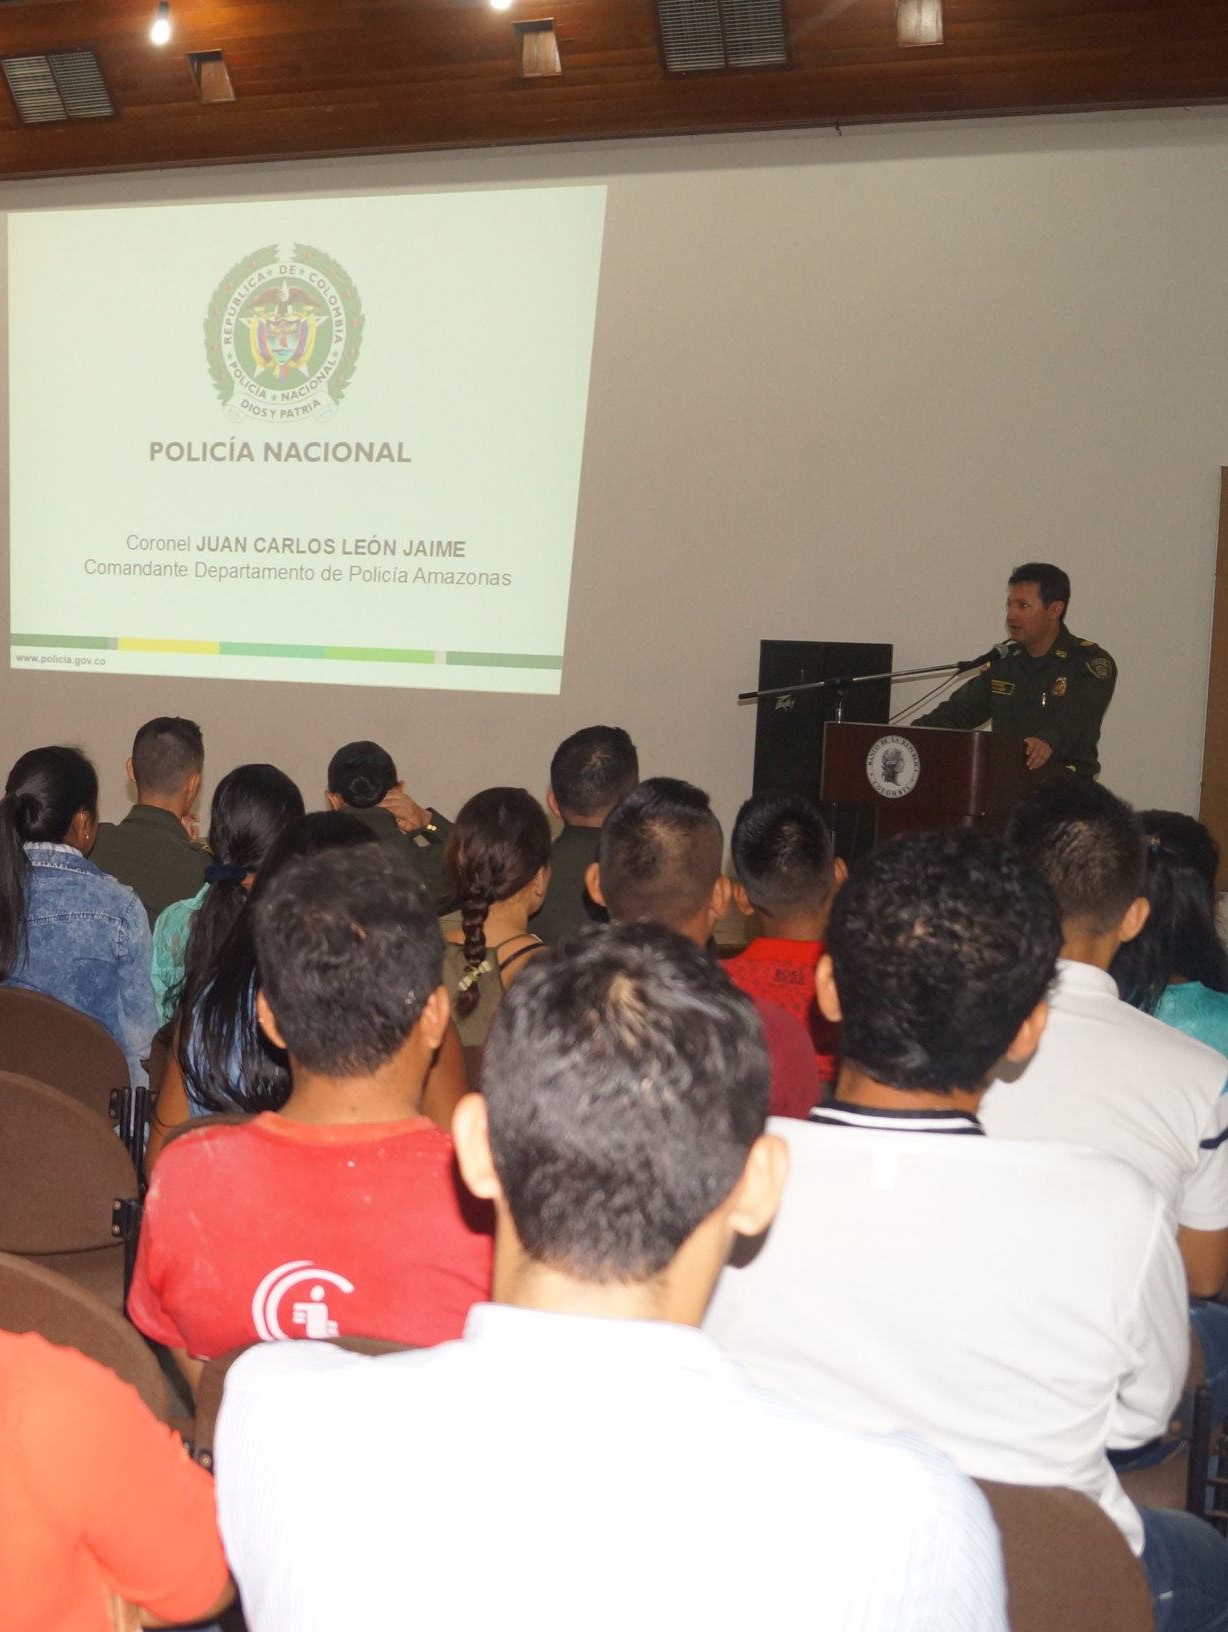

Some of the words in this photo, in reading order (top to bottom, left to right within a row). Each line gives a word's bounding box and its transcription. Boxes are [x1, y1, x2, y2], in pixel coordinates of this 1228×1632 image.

[278, 265, 296, 275] DE
[309, 272, 344, 344] COLOMBIA
[281, 356, 337, 402] NACIONAL
[240, 399, 268, 418] DIOS
[269, 409, 278, 419] Y
[280, 399, 322, 419] PATRIA
[149, 435, 255, 463] POLICÍA
[263, 441, 412, 463] NACIONAL
[126, 534, 191, 551] Coronel
[196, 535, 247, 553] JUAN
[254, 537, 336, 555] CARLOS
[342, 534, 397, 556] LEÓN
[402, 540, 467, 558] JAIME
[84, 558, 188, 577] Comandante
[194, 561, 315, 582] Departamento
[321, 565, 343, 582] de
[349, 564, 408, 584] Policía
[412, 567, 512, 586] Amazonas
[15, 654, 106, 667] www.policia.gov.co
